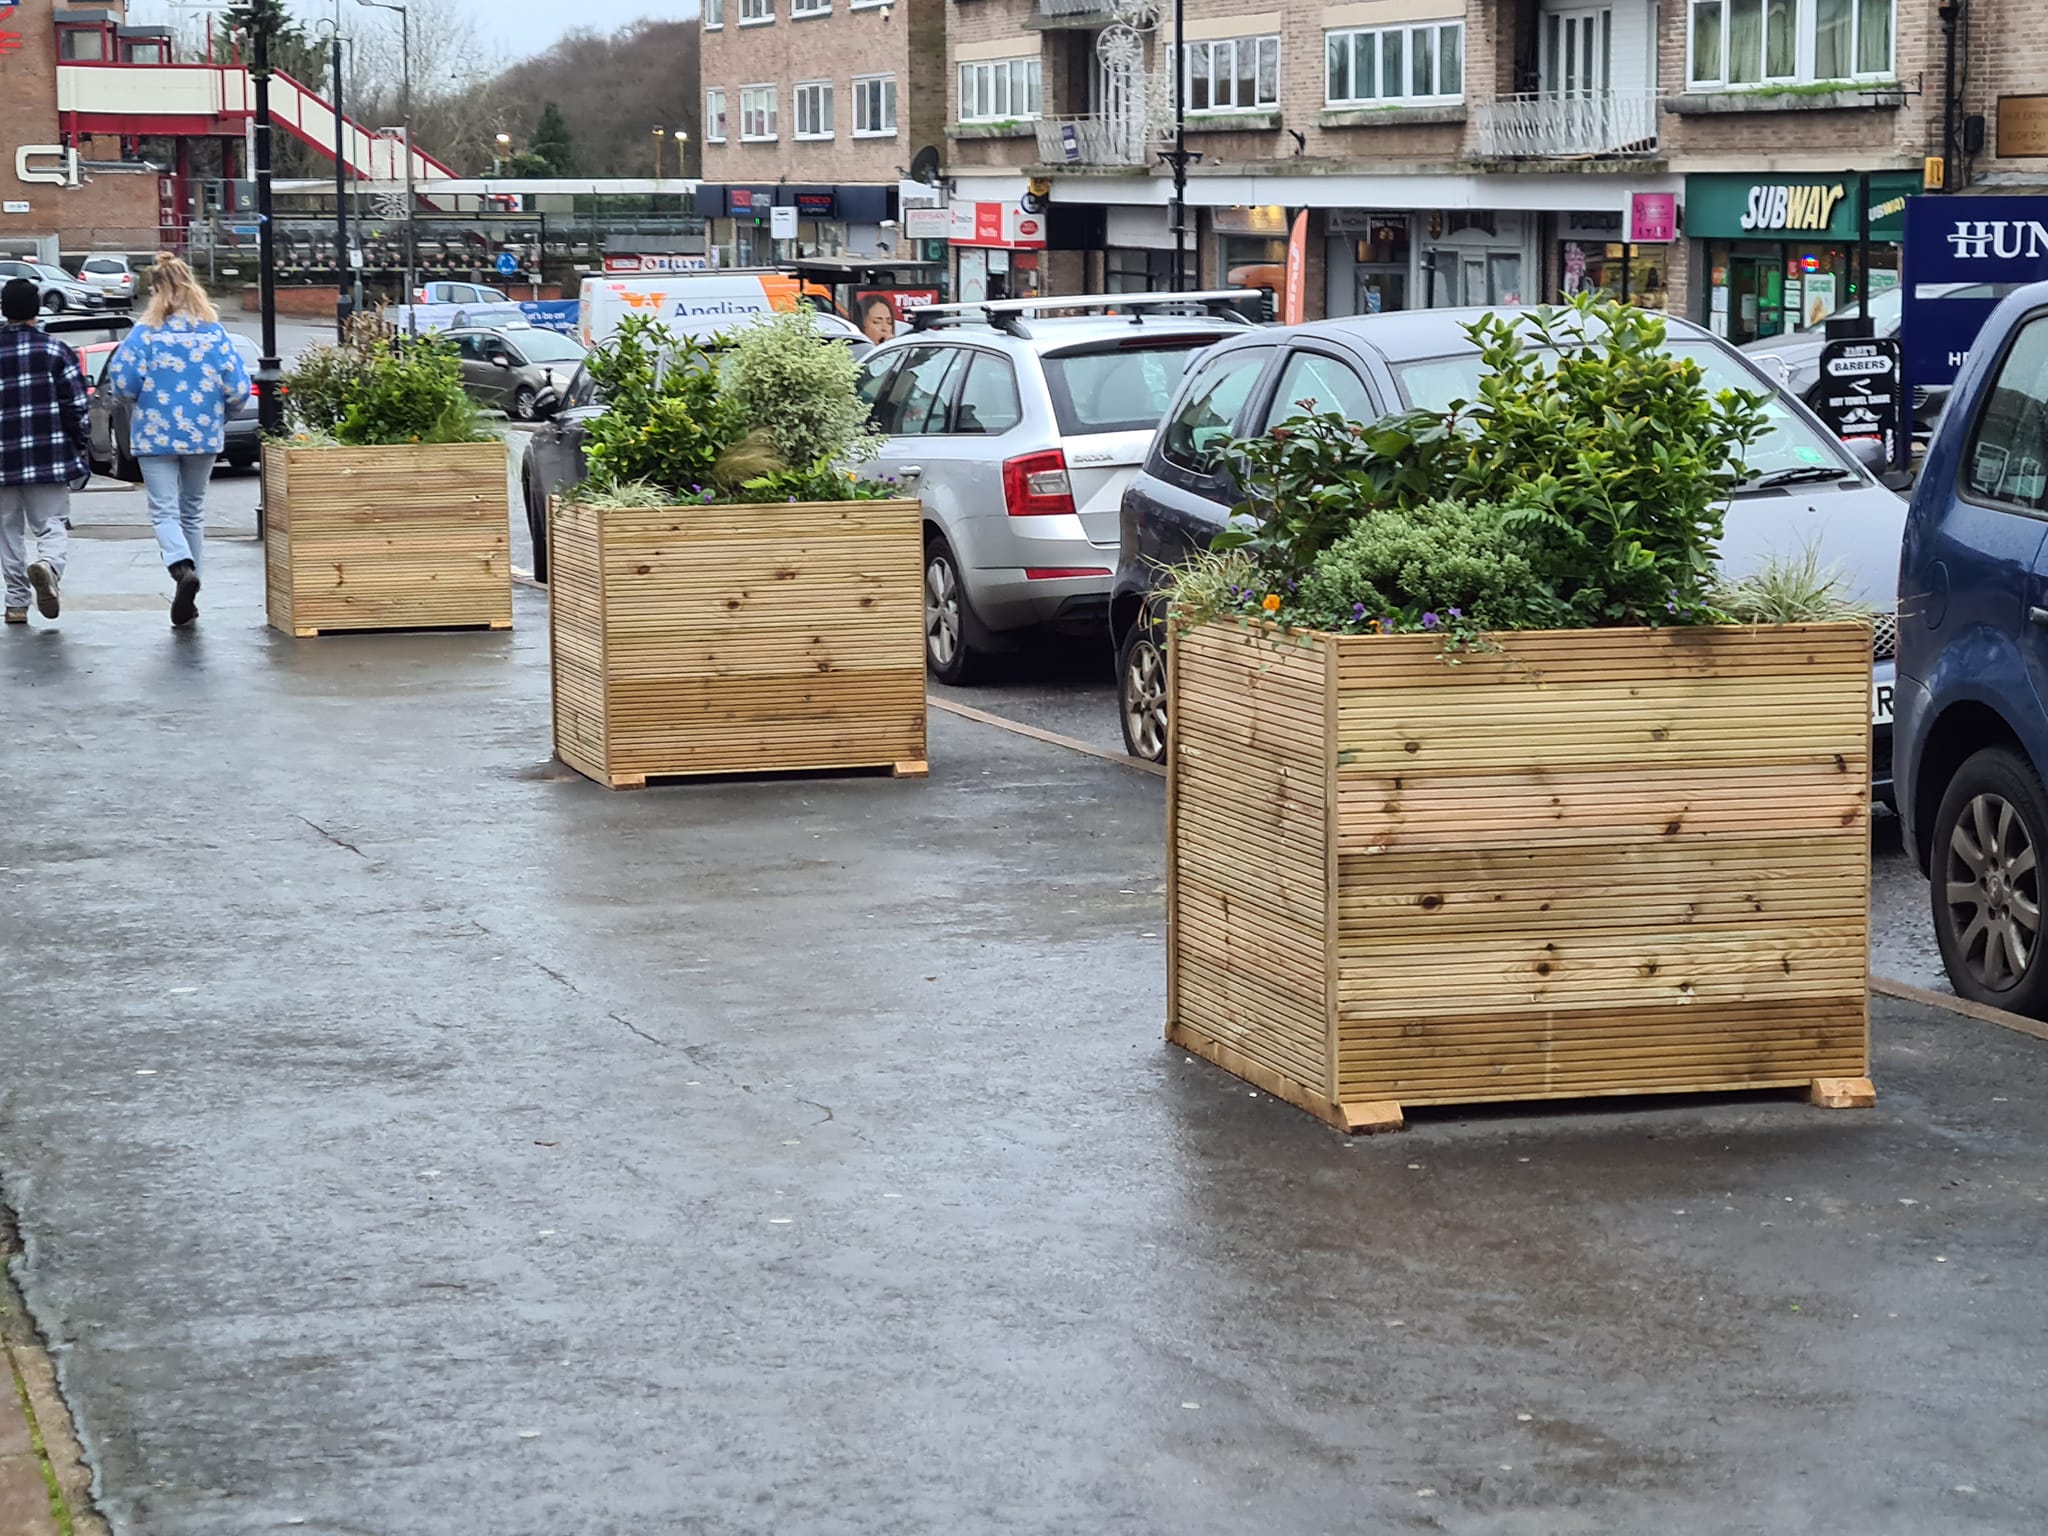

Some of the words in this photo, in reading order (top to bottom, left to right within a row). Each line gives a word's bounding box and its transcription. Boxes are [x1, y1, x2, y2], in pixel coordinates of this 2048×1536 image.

[1740, 184, 1844, 230] SUBWAY
[1868, 196, 1906, 222] UBWAY
[1834, 359, 1887, 372] BARBERS
